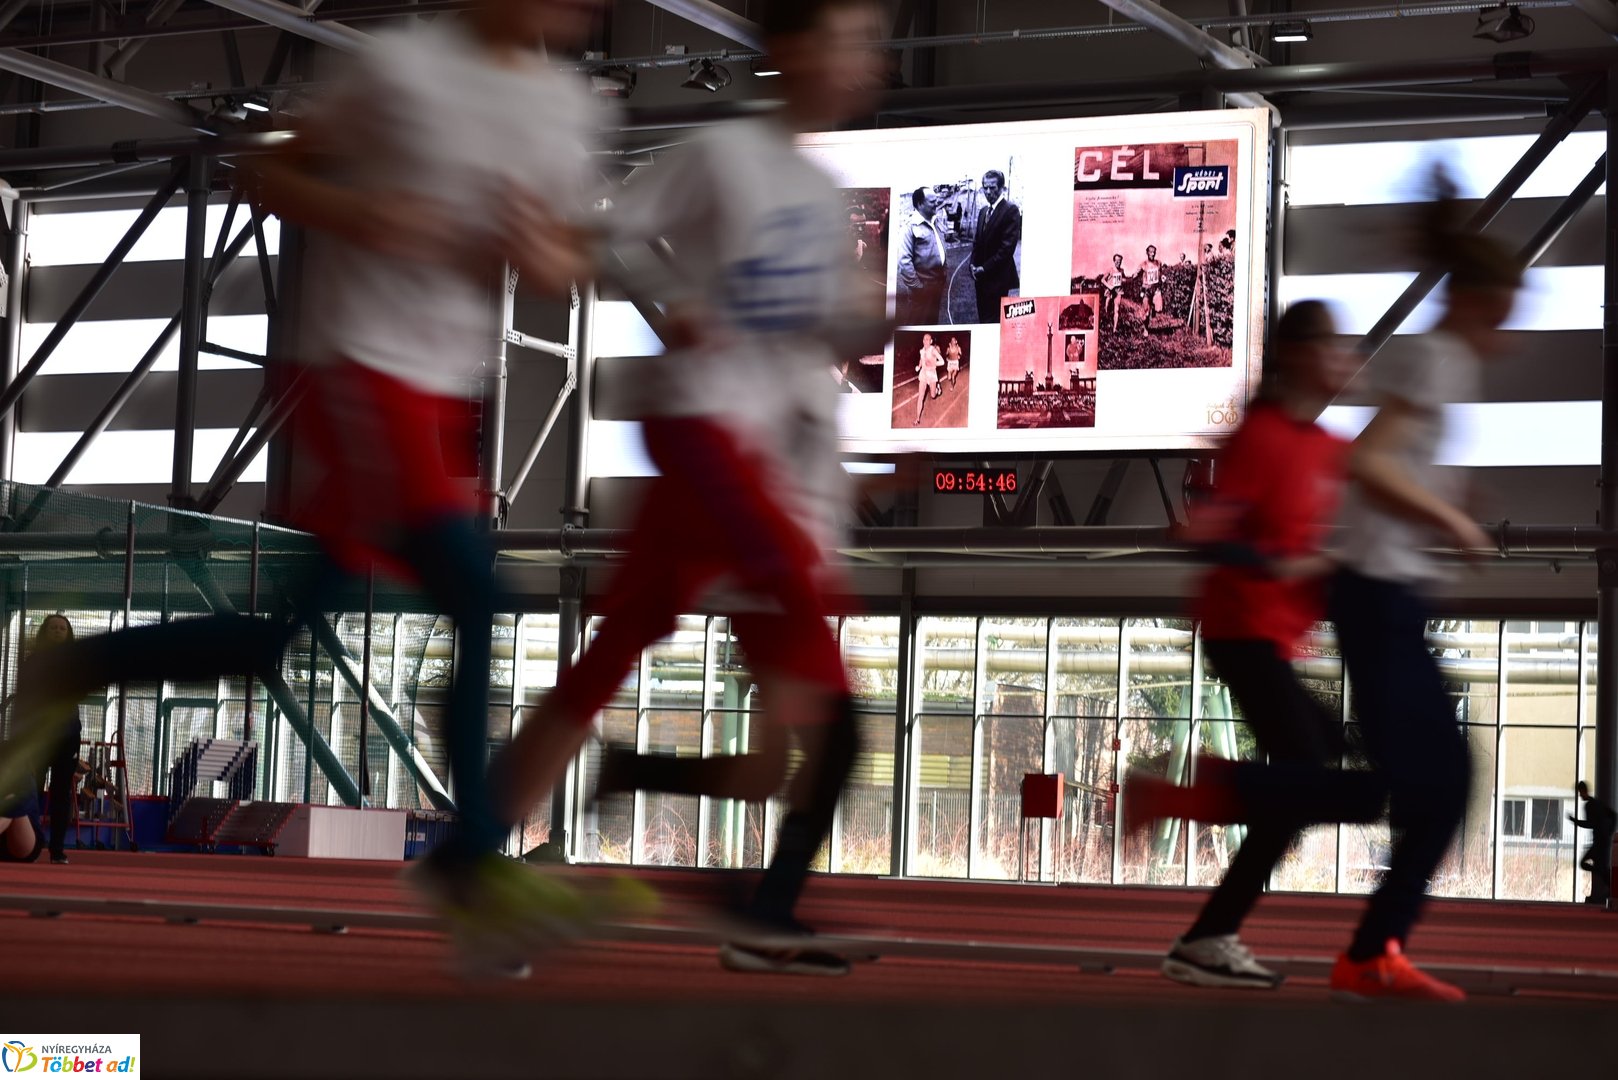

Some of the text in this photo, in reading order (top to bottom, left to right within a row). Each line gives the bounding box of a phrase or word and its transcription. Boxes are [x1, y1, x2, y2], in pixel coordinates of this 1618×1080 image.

[1077, 146, 1160, 182] CÉL
[1177, 172, 1224, 194] Sport
[935, 472, 1016, 492] 09:54:46
